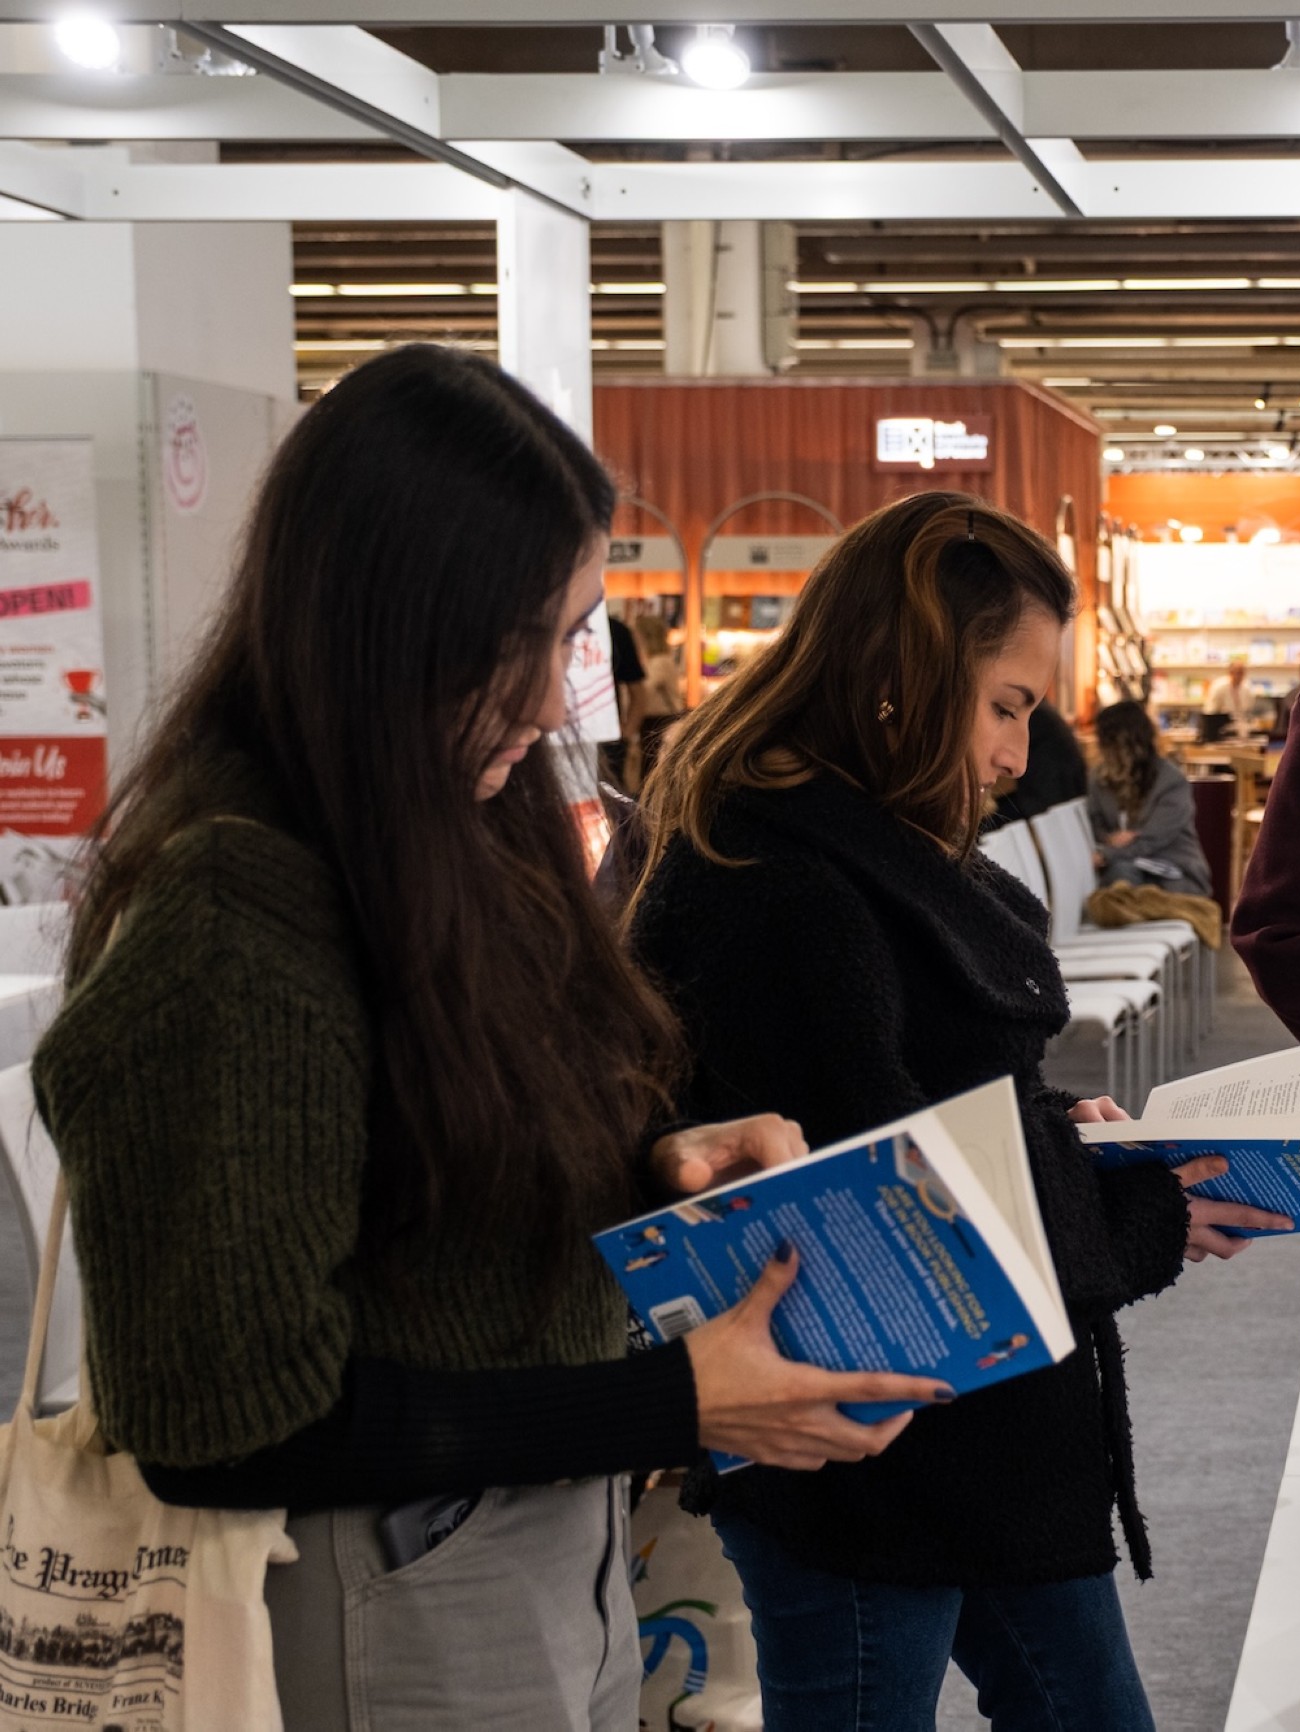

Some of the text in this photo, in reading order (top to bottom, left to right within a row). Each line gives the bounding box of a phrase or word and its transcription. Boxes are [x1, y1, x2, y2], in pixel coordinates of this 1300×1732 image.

[0, 748, 31, 778] oin
[36, 1547, 132, 1599] Prag
[0, 1684, 47, 1713] harles
[53, 1695, 99, 1723] Bridg
